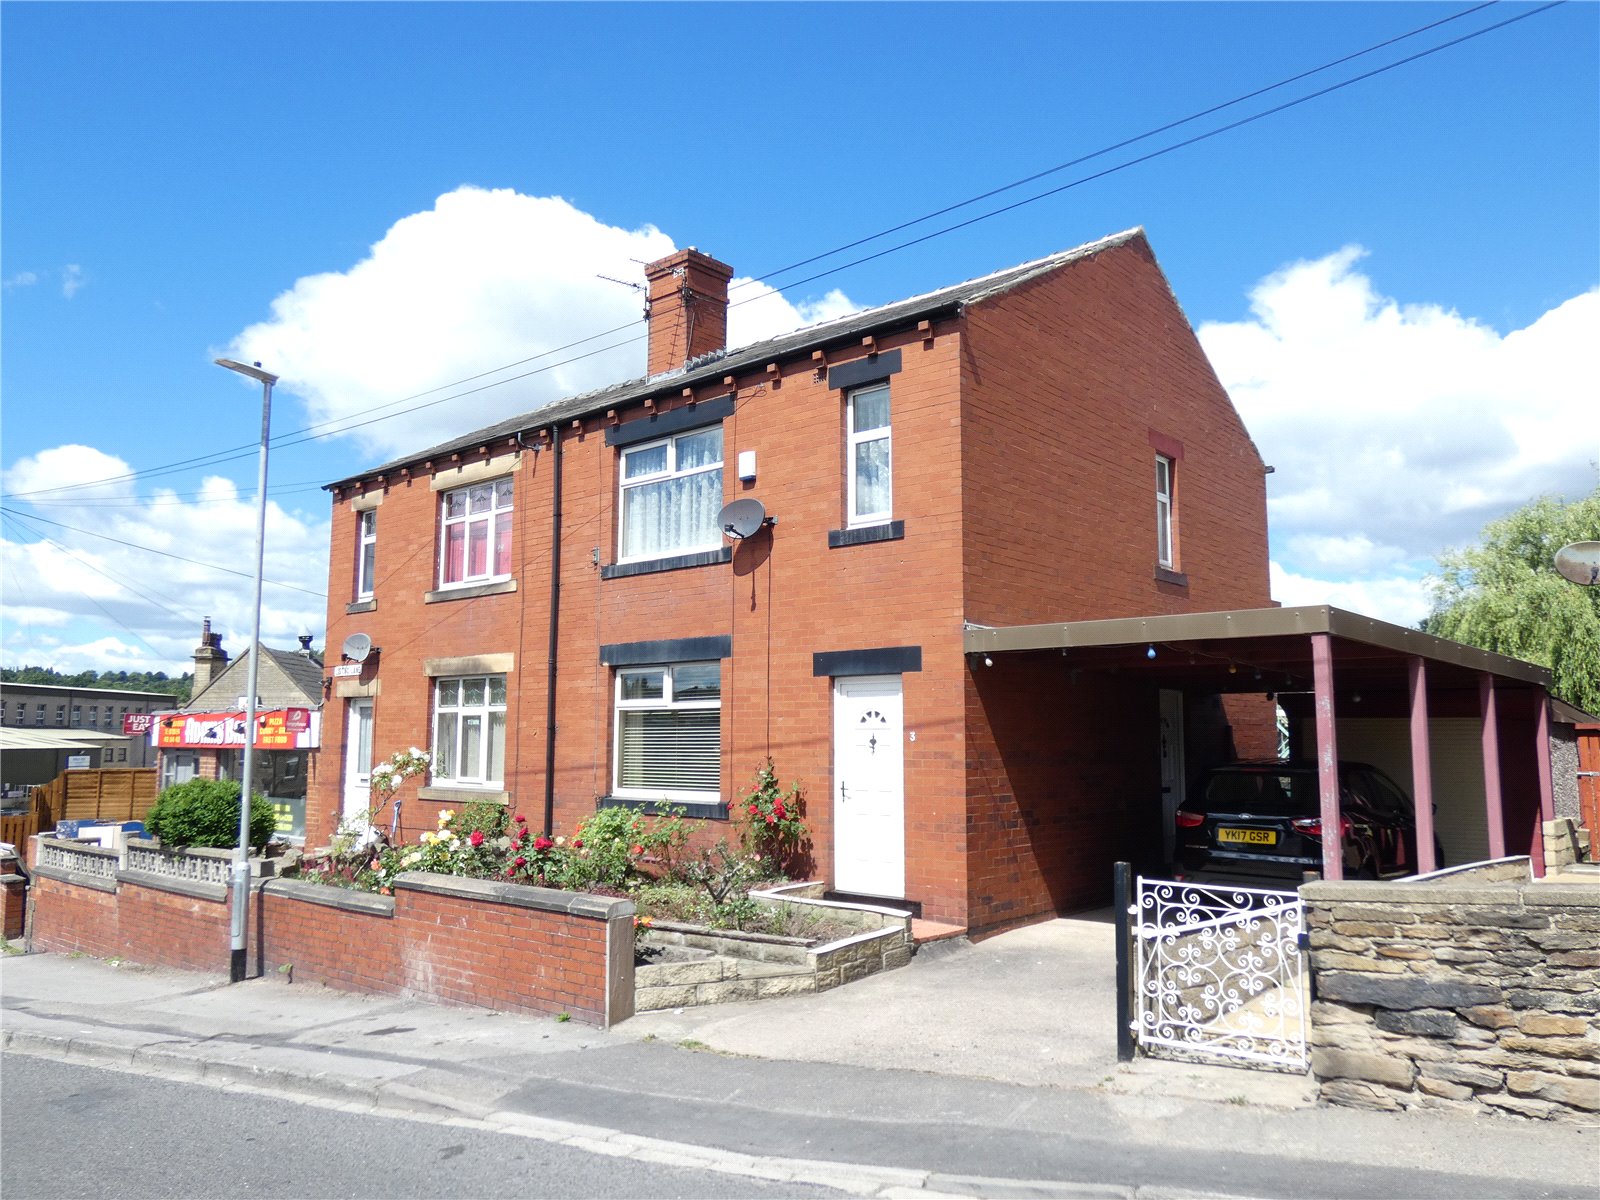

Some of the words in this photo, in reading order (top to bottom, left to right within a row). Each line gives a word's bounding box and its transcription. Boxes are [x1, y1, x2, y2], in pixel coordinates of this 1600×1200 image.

[127, 715, 151, 723] JUST
[132, 723, 151, 731] EAT
[909, 731, 916, 741] 3
[1224, 830, 1248, 841] YK17
[1249, 832, 1270, 842] GSR
